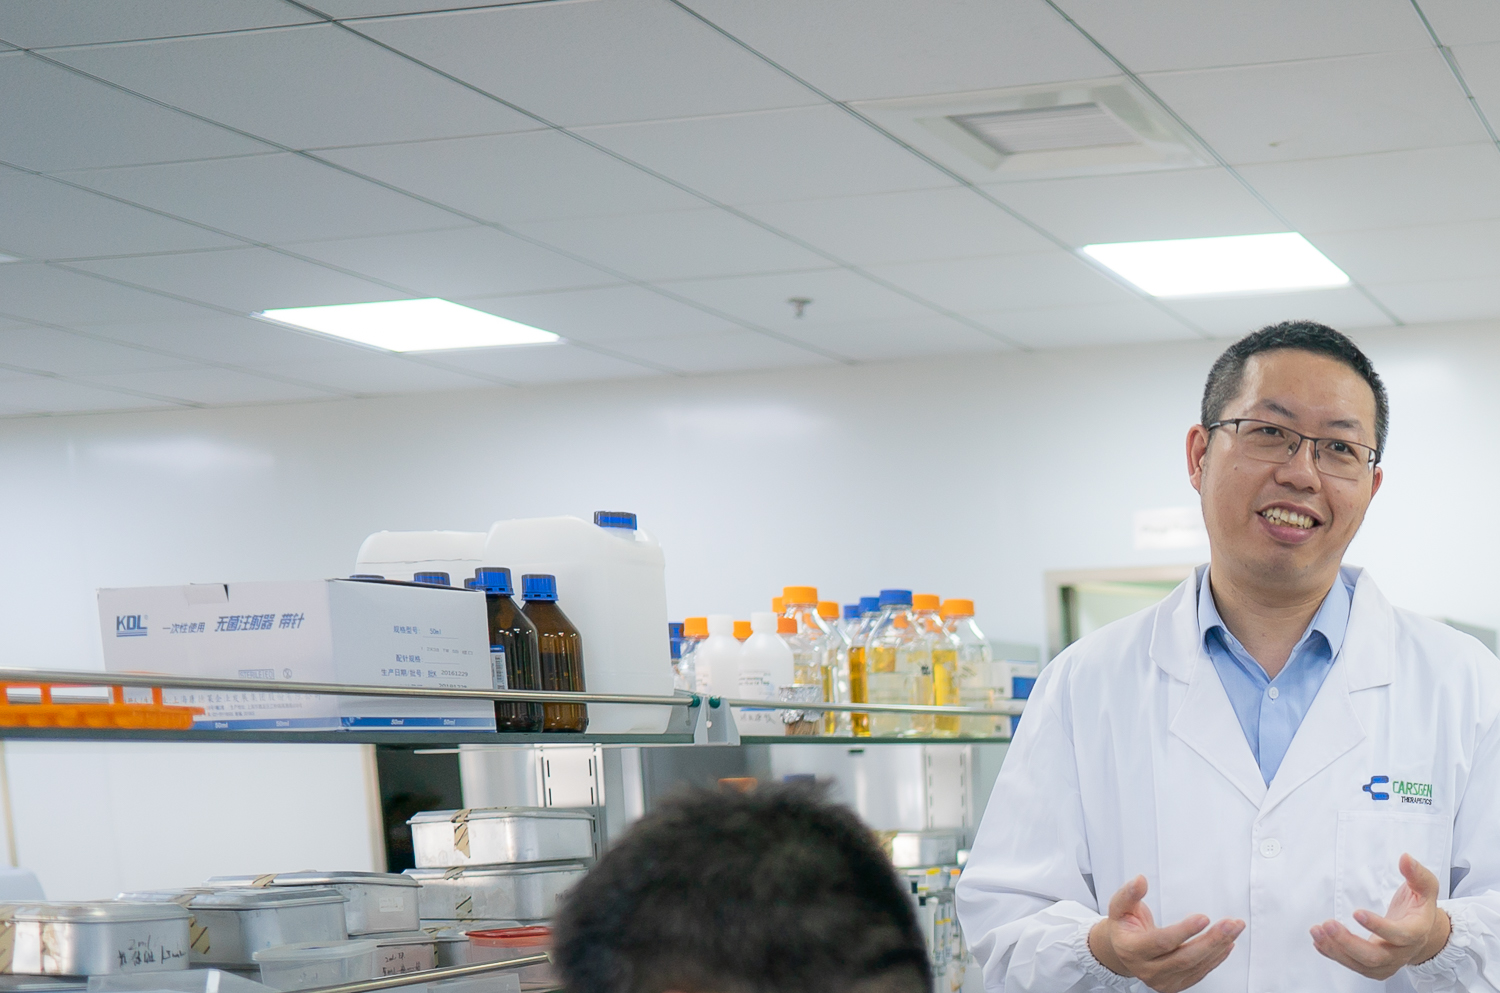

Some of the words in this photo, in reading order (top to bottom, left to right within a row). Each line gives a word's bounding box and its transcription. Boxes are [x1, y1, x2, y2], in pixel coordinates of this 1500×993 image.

[116, 615, 147, 631] KDL
[162, 622, 205, 634] 一次性使用
[214, 613, 276, 632] 无菌注射器
[278, 612, 305, 630] 带针
[1392, 780, 1433, 798] CARSGEN
